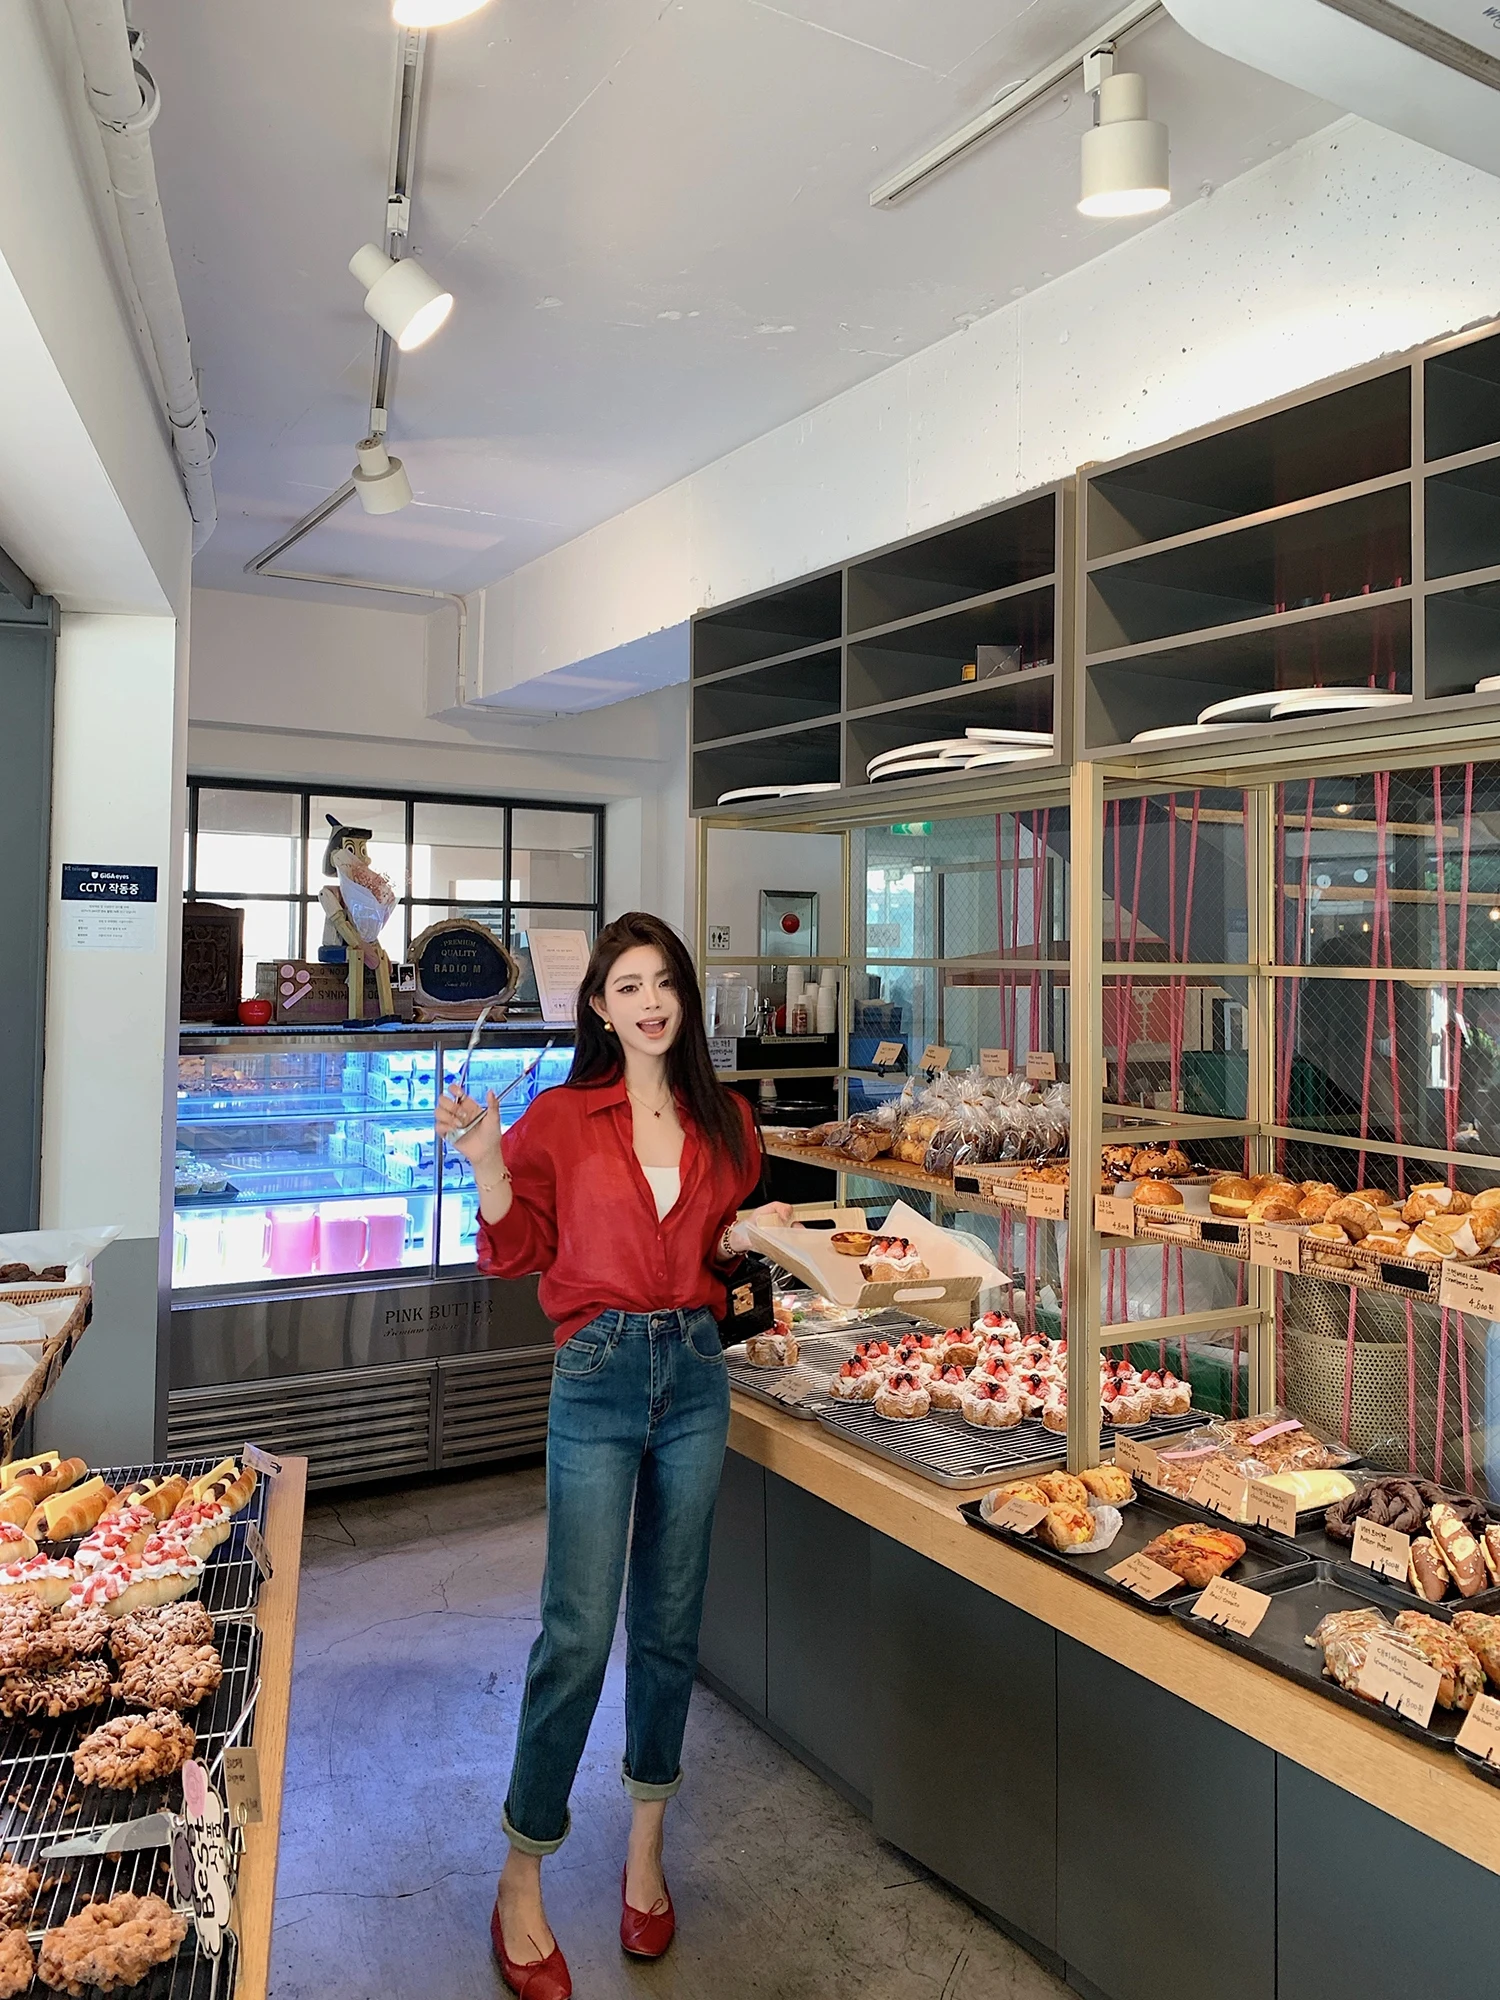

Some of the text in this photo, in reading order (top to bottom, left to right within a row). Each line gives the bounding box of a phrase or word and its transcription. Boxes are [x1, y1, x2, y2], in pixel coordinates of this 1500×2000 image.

[79, 882, 139, 895] CCTV 작동중
[443, 939, 476, 947] PREMIUM
[440, 949, 478, 957] QUALITY
[434, 964, 481, 973] RADIO M
[385, 1299, 494, 1324] PINK BUTTER
[194, 1814, 215, 1919] Best
